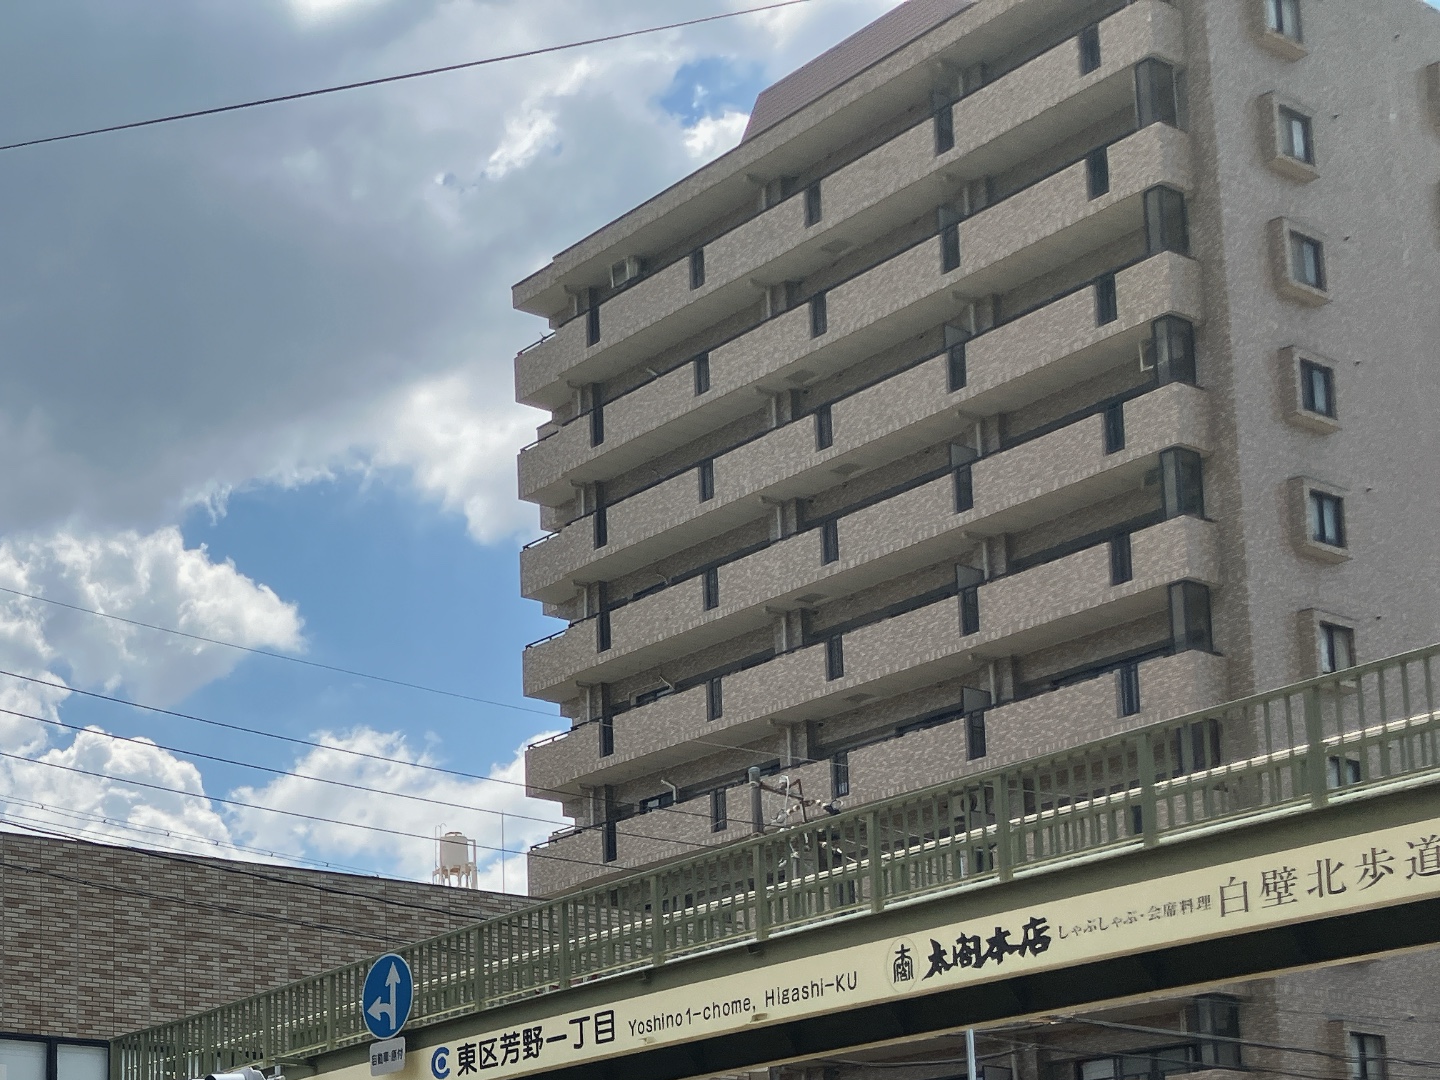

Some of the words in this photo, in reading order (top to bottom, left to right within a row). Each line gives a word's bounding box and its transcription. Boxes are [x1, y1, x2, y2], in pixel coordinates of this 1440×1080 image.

[1219, 834, 1440, 918] 白壁北歩道
[457, 1009, 615, 1077] 東区芳野一丁目
